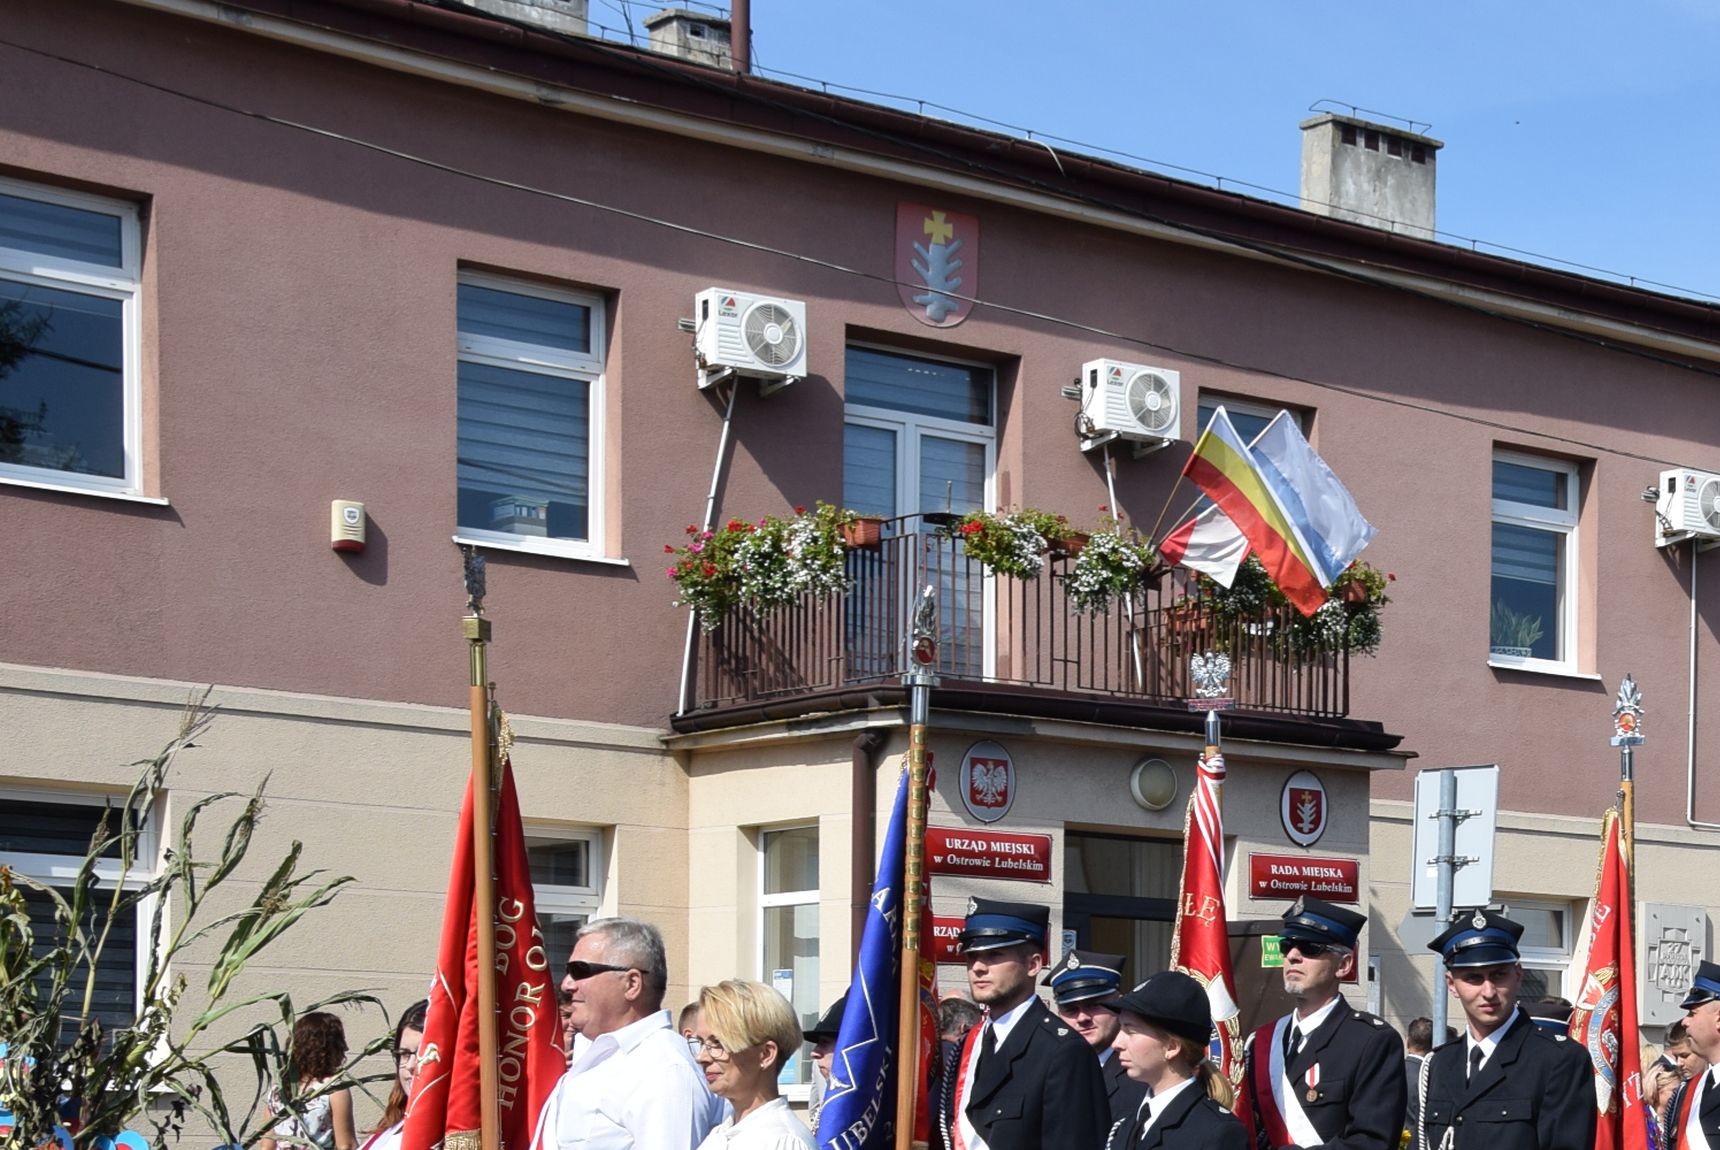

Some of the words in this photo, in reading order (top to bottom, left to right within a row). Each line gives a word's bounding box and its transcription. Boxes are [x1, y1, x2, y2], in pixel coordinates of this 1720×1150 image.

[945, 838, 987, 853] URZĄD
[990, 841, 1035, 855] MIEJSKI
[933, 855, 943, 863] w
[947, 854, 991, 867] Ostrowie
[994, 857, 1044, 871] Lubelskim
[1270, 864, 1300, 876] RADA
[1302, 866, 1344, 879] MIEJSKA
[1259, 881, 1268, 889] w
[1270, 879, 1308, 890] Ostrowie
[1311, 881, 1353, 893] Lubelskim
[1182, 892, 1221, 928] ŁĘ
[933, 926, 960, 939] RZĄD
[498, 981, 546, 1111] HONOR
